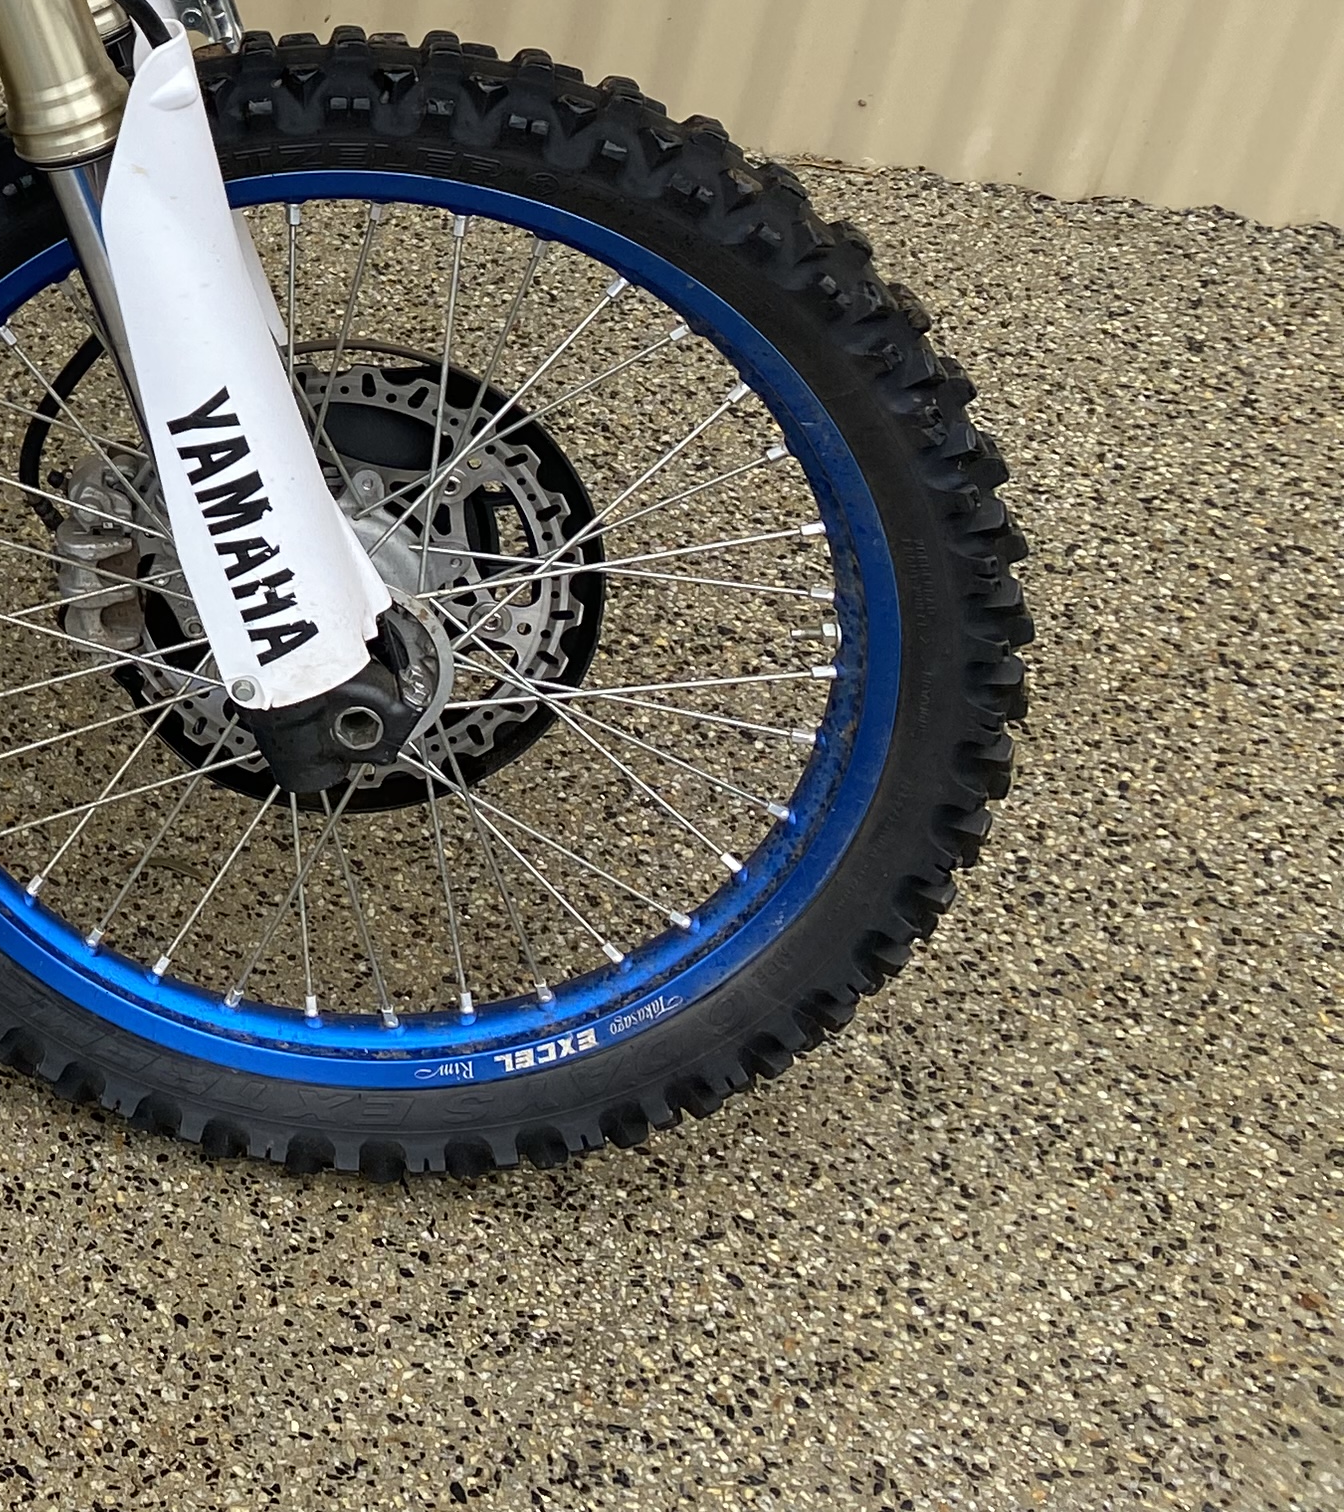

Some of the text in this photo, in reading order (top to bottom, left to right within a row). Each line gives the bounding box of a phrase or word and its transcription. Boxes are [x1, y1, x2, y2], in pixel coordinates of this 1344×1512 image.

[166, 385, 320, 667] YAMAHA
[414, 995, 684, 1081] Takasago EXCEL Rim
